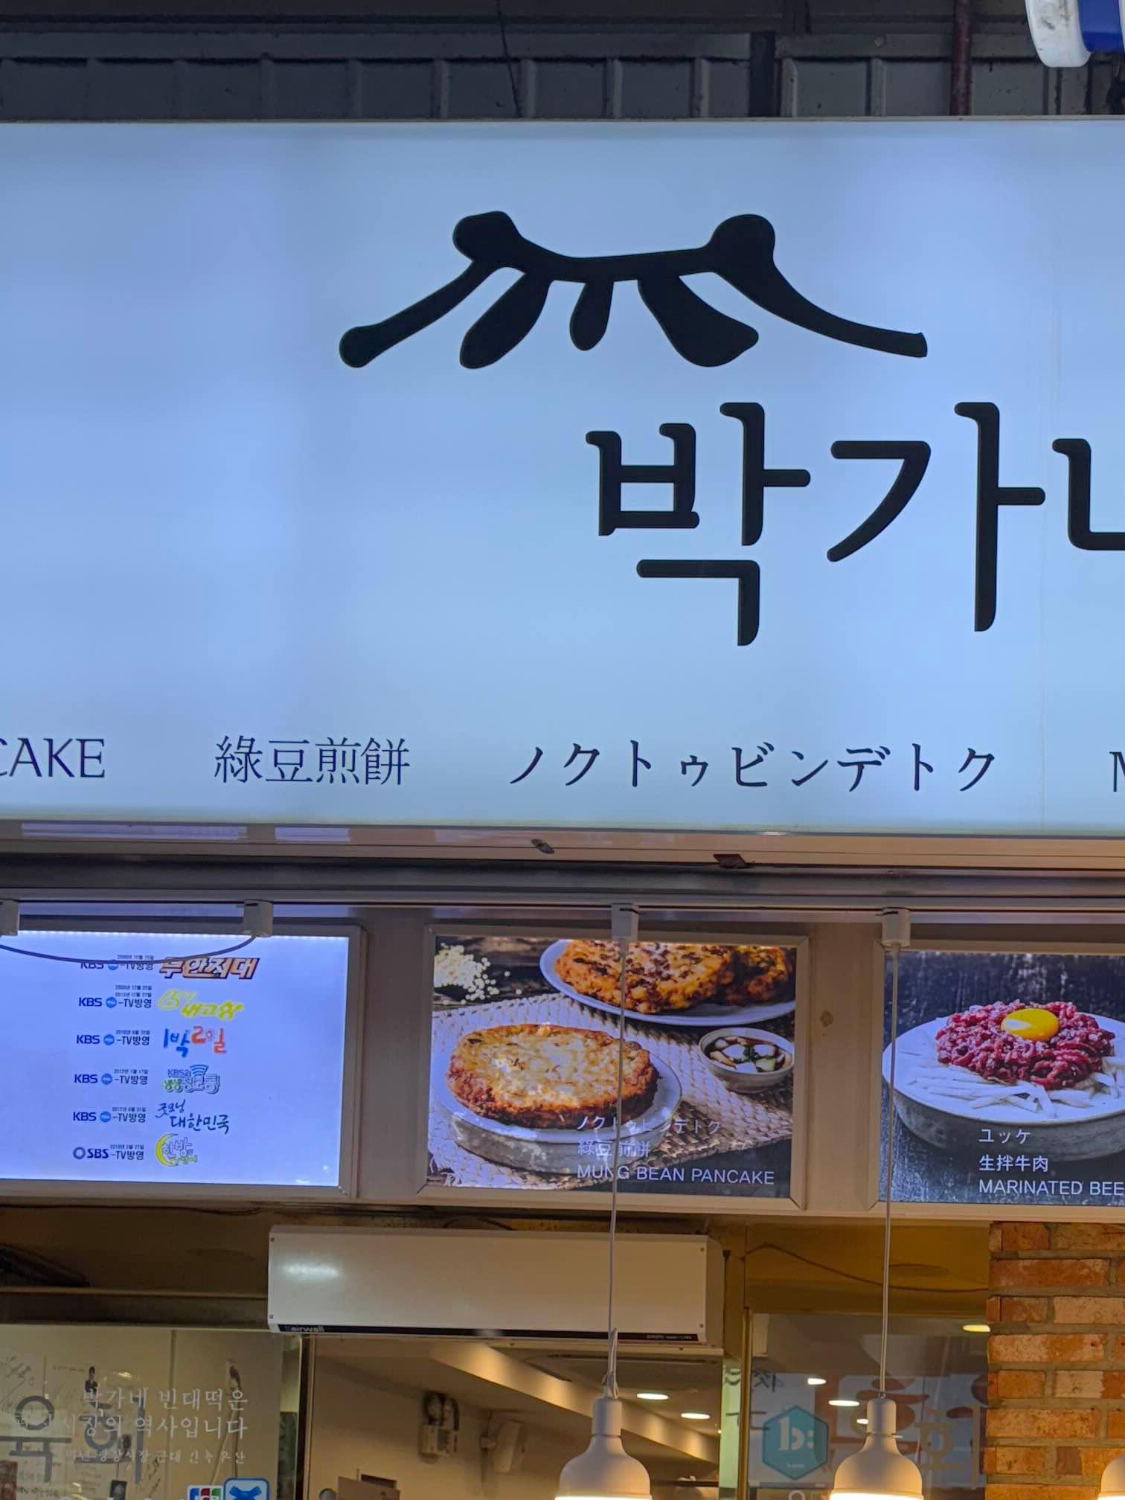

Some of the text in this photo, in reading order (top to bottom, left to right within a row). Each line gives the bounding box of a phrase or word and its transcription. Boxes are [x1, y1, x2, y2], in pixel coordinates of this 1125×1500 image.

[213, 735, 411, 787] 綠豆煎餅
[509, 739, 998, 794] ノクトゥビンデトク
[78, 996, 103, 1007] KBS
[76, 1034, 101, 1045] KBS
[74, 1073, 98, 1084] KBS
[73, 1111, 97, 1122] KBS
[170, 1112, 230, 1134] 대한민국
[978, 1128, 1032, 1146] ユッケ
[87, 1147, 109, 1159] SBS
[978, 1154, 1050, 1173] 生拌牛肉
[636, 1166, 685, 1182] BEAN
[691, 1168, 775, 1185] PANCAKE
[978, 1179, 1083, 1196] MARINATED
